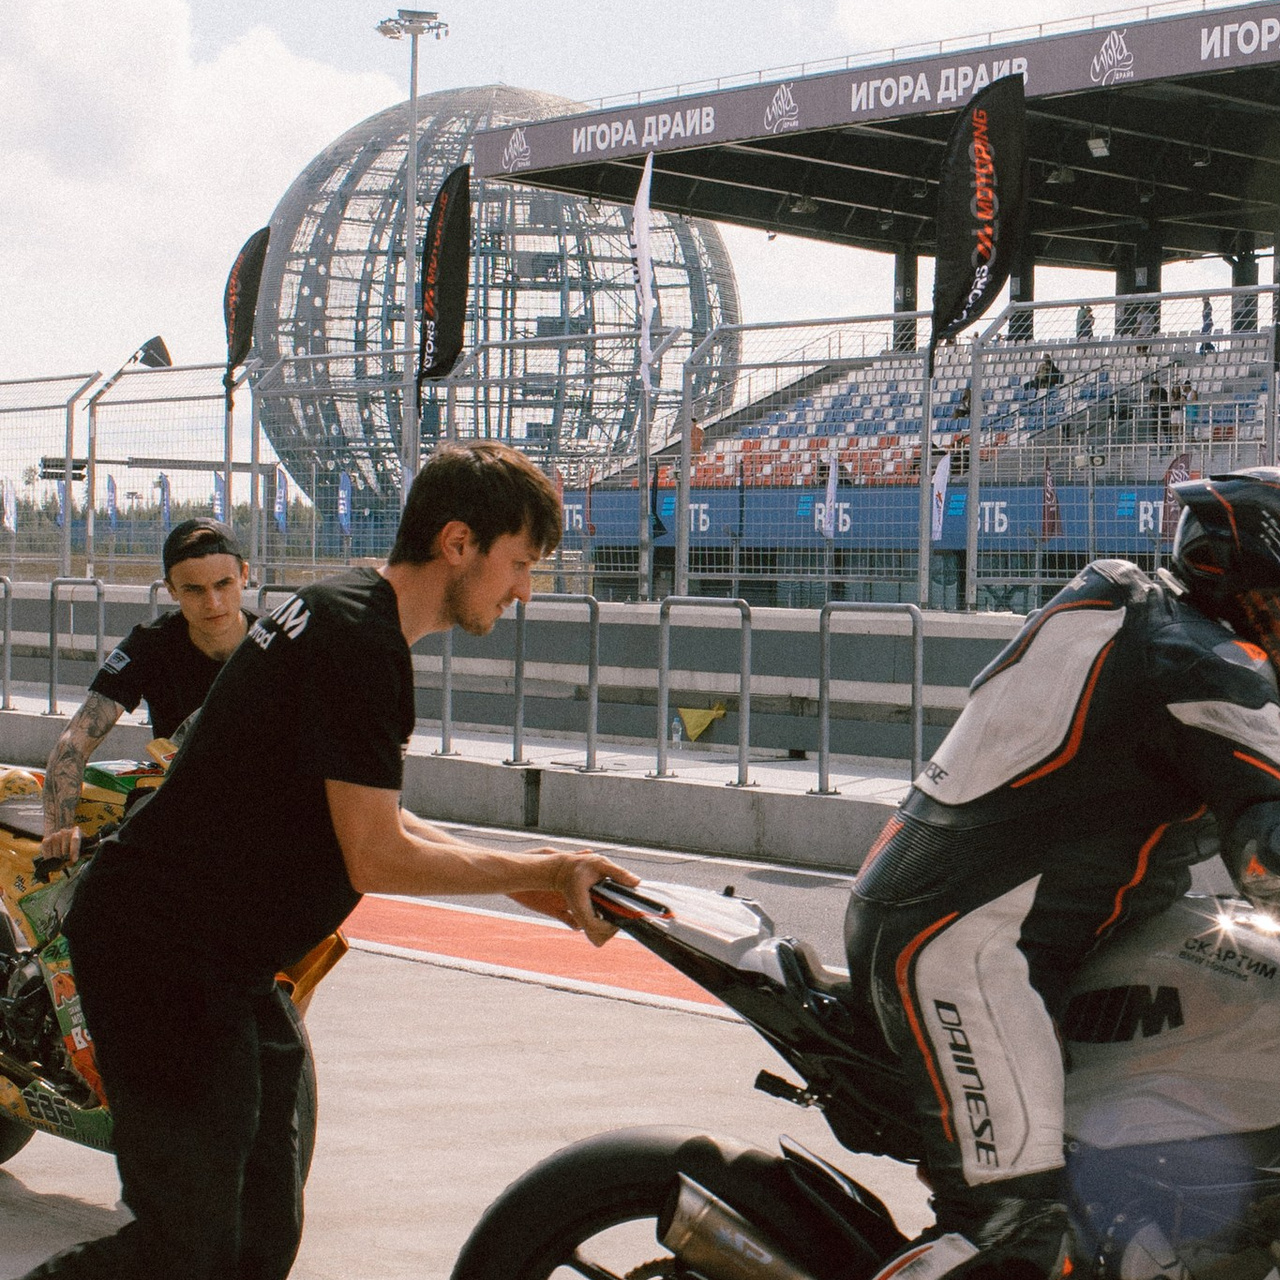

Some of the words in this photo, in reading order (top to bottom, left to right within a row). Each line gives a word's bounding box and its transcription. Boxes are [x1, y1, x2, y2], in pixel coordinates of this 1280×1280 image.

[851, 75, 931, 112] ИГОРА
[572, 118, 638, 154] ИГОРА
[564, 504, 583, 530] ТБ
[689, 503, 710, 532] ТБ
[814, 502, 851, 533] ВБ
[1139, 500, 1164, 534] ВТ
[933, 998, 999, 1168] DAINESE
